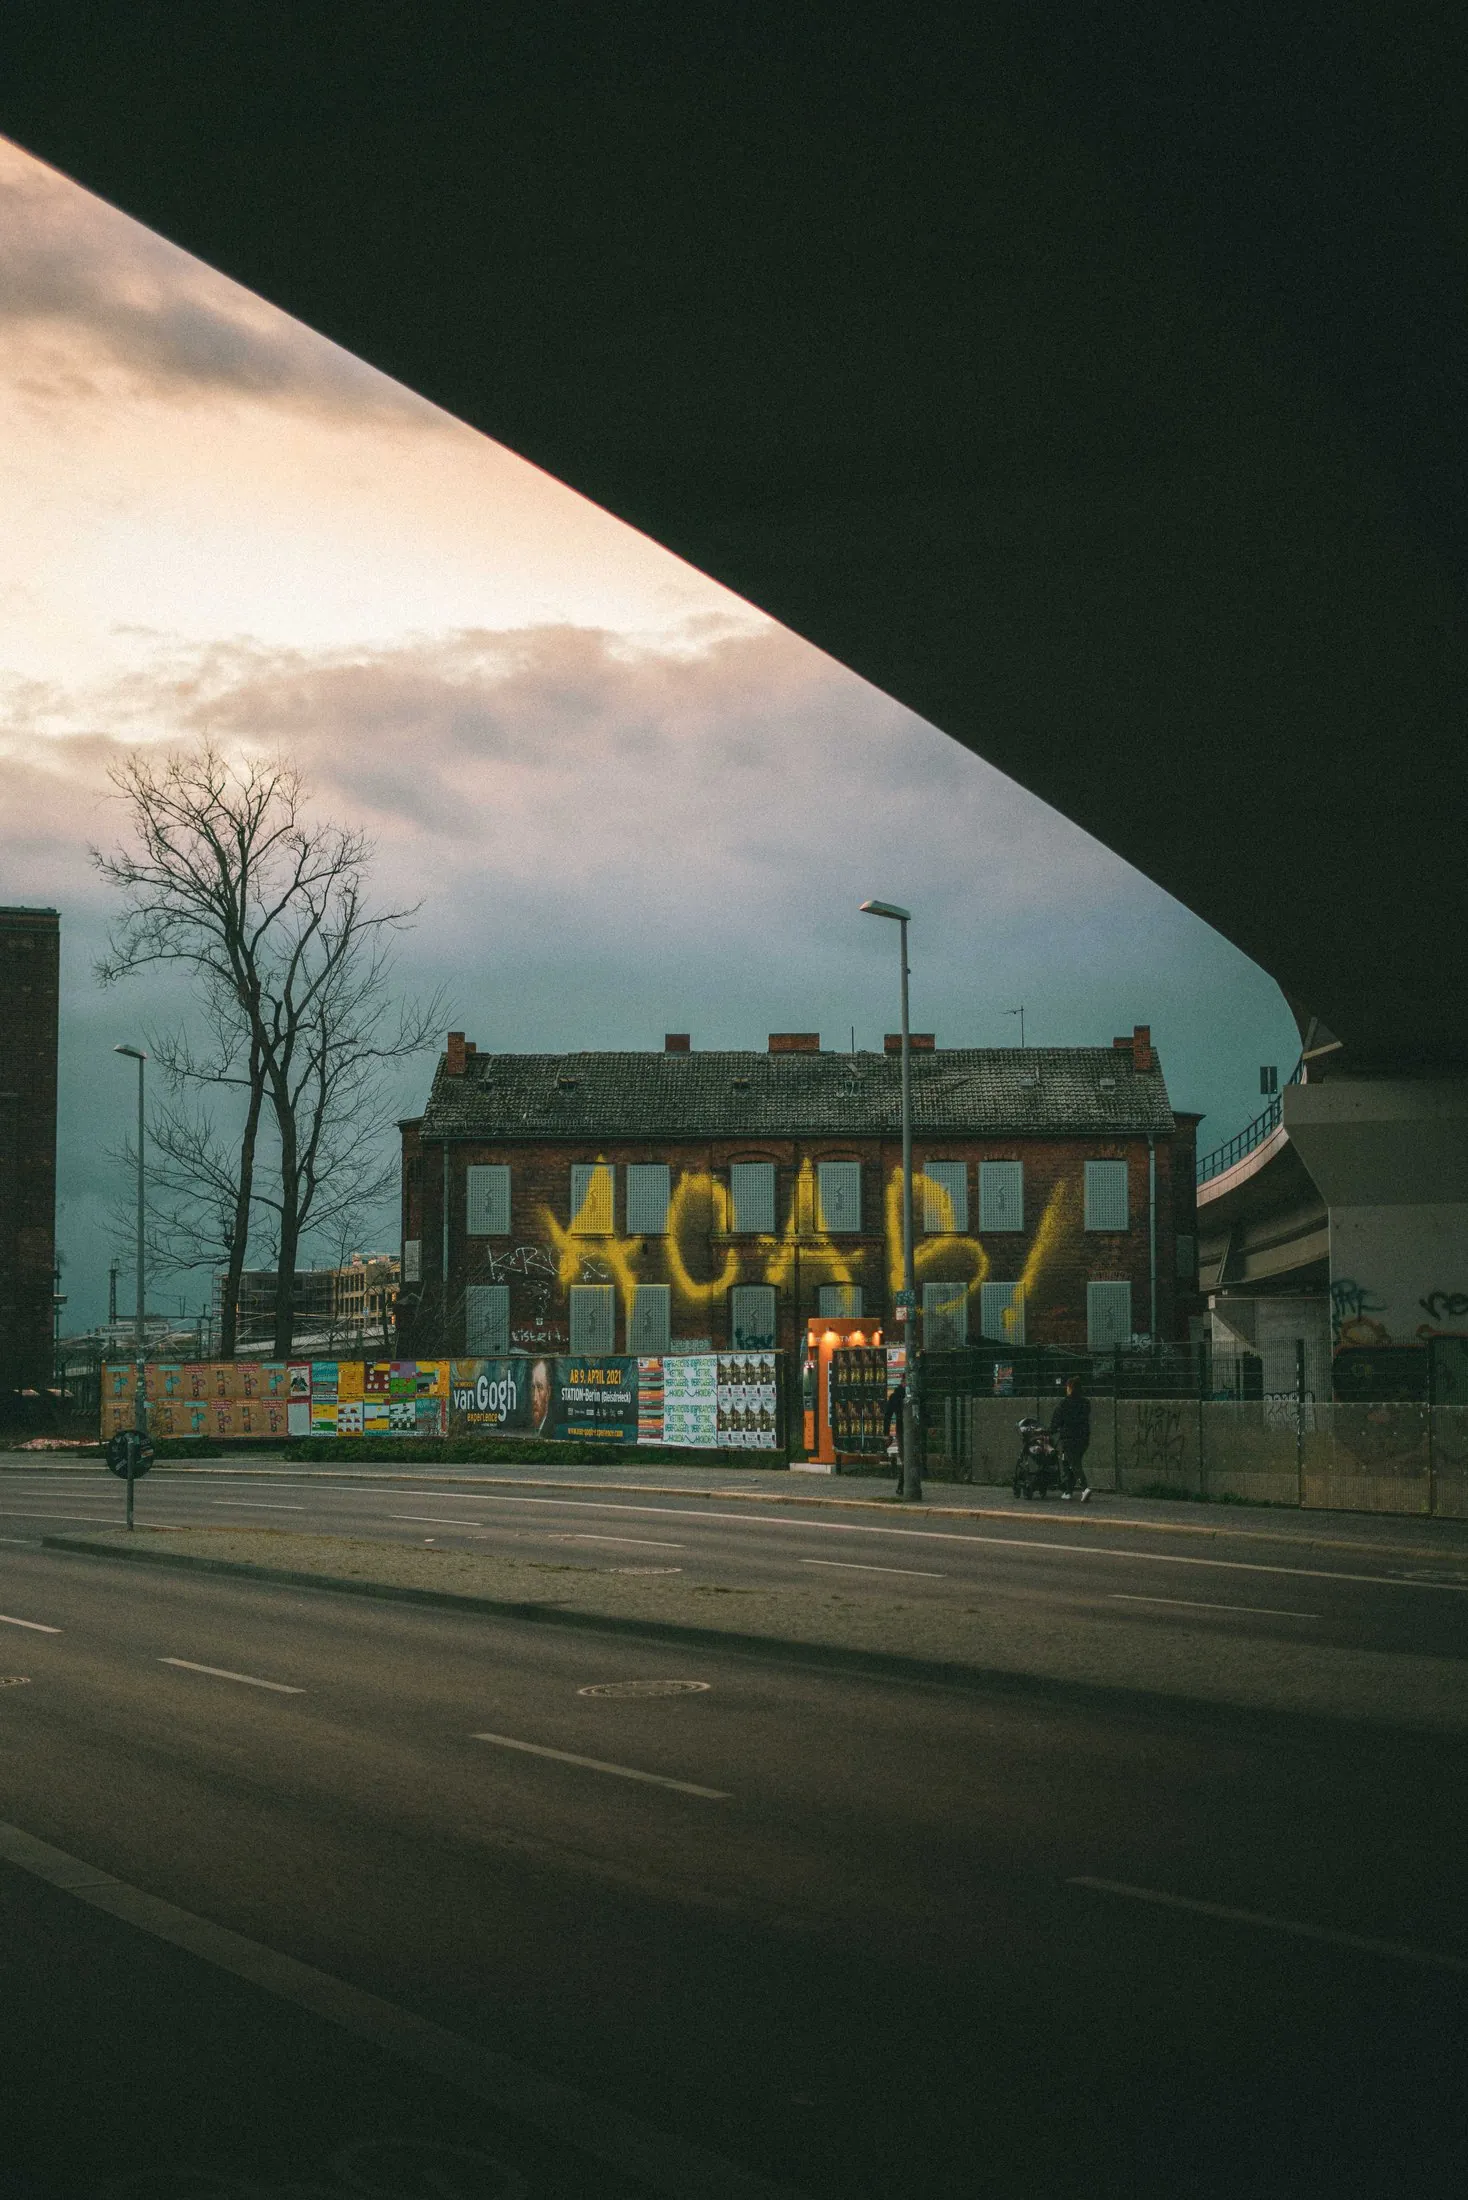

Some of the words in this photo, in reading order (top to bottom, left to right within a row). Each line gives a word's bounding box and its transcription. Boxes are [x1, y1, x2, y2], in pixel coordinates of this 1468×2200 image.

[570, 1369, 579, 1384] AB
[580, 1370, 586, 1384] 9.
[587, 1369, 605, 1385] APRIL
[606, 1370, 621, 1385] 2021
[453, 1388, 475, 1410] van
[476, 1369, 517, 1422] Gogh
[467, 1412, 498, 1425] experience
